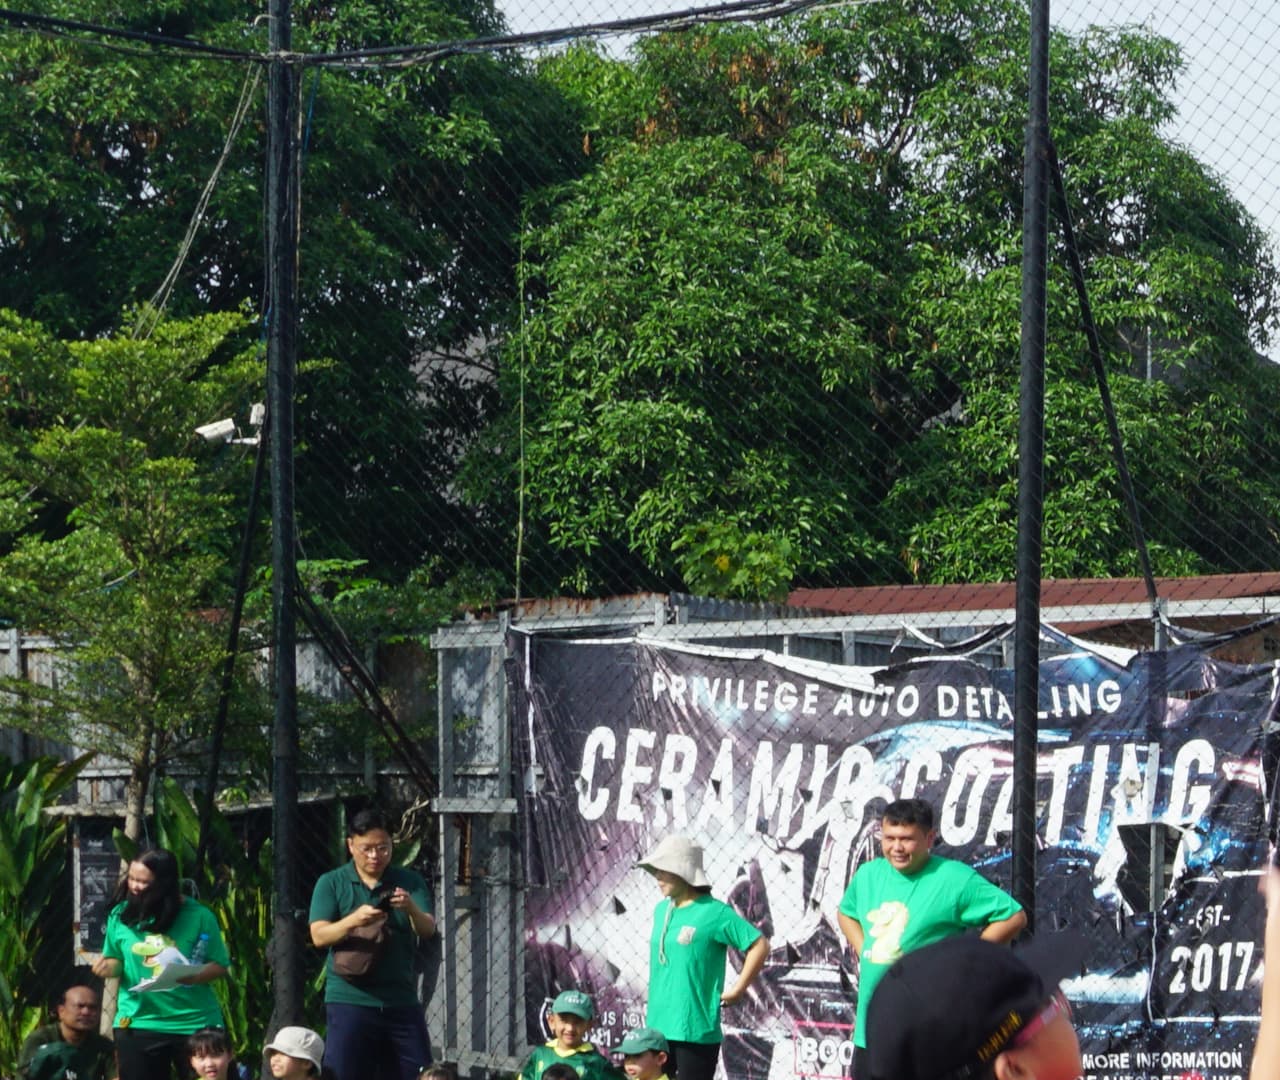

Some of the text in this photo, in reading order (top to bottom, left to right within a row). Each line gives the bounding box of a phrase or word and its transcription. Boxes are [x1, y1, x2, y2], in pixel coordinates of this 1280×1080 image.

[652, 671, 1122, 721] PRIVILEGE AUTO DETAING
[1169, 941, 1255, 994] 2017
[800, 1036, 855, 1066] BOO
[1083, 1051, 1243, 1070] MORE INFORMATION
